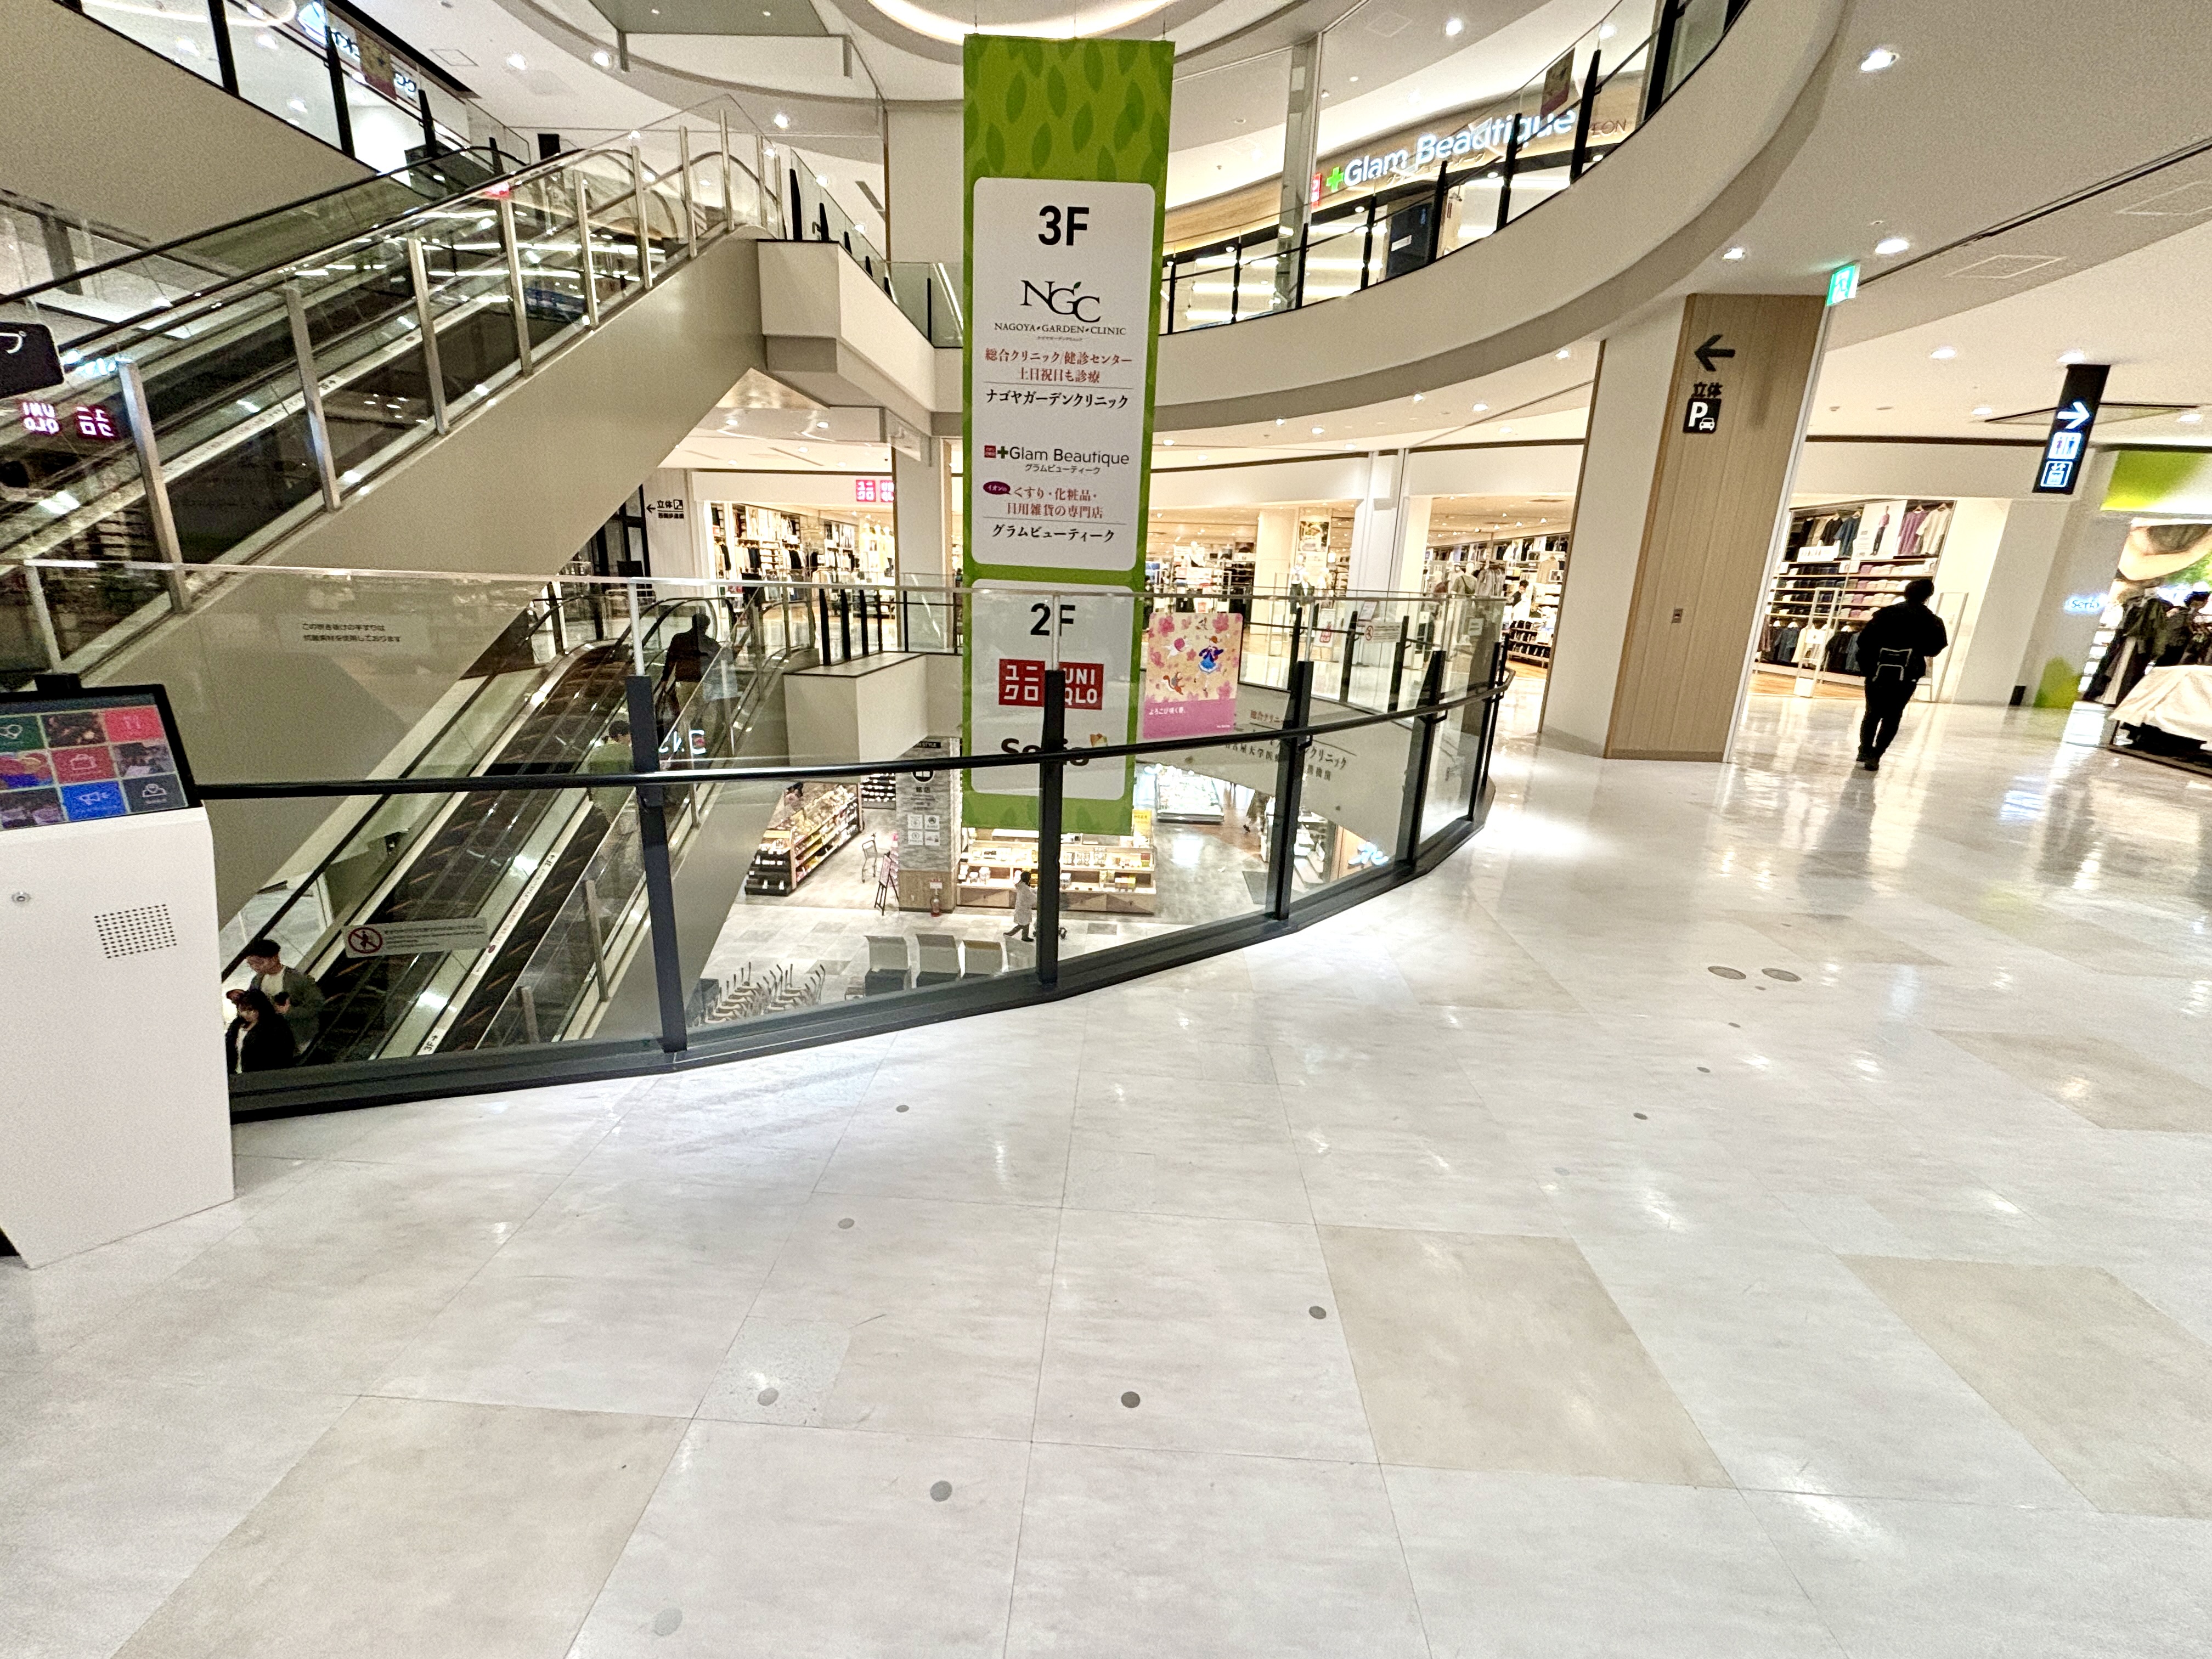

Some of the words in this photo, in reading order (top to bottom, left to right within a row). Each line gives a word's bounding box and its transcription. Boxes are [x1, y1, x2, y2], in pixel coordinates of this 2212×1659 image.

[1344, 147, 1407, 187] Glam
[1038, 205, 1090, 246] 3F
[1020, 280, 1101, 323] NGC
[995, 323, 1036, 332] NAGOYA
[1042, 324, 1085, 334] GARDEN
[1091, 326, 1126, 335] CLINIC
[1019, 367, 1101, 383] 土日祝日も診療
[986, 388, 1128, 409] ナゴヤガーデンクリニック
[1692, 382, 1723, 398] 立体
[1688, 401, 1708, 427] P
[1009, 447, 1048, 461] Glam
[1053, 448, 1130, 467] Beautique
[1025, 464, 1101, 474] グラムビューティーク
[657, 500, 673, 509] 立体
[1007, 503, 1103, 519] 日用雑貨の専門店
[992, 523, 1115, 543] グラムビューティーク
[1030, 603, 1075, 636] 2F
